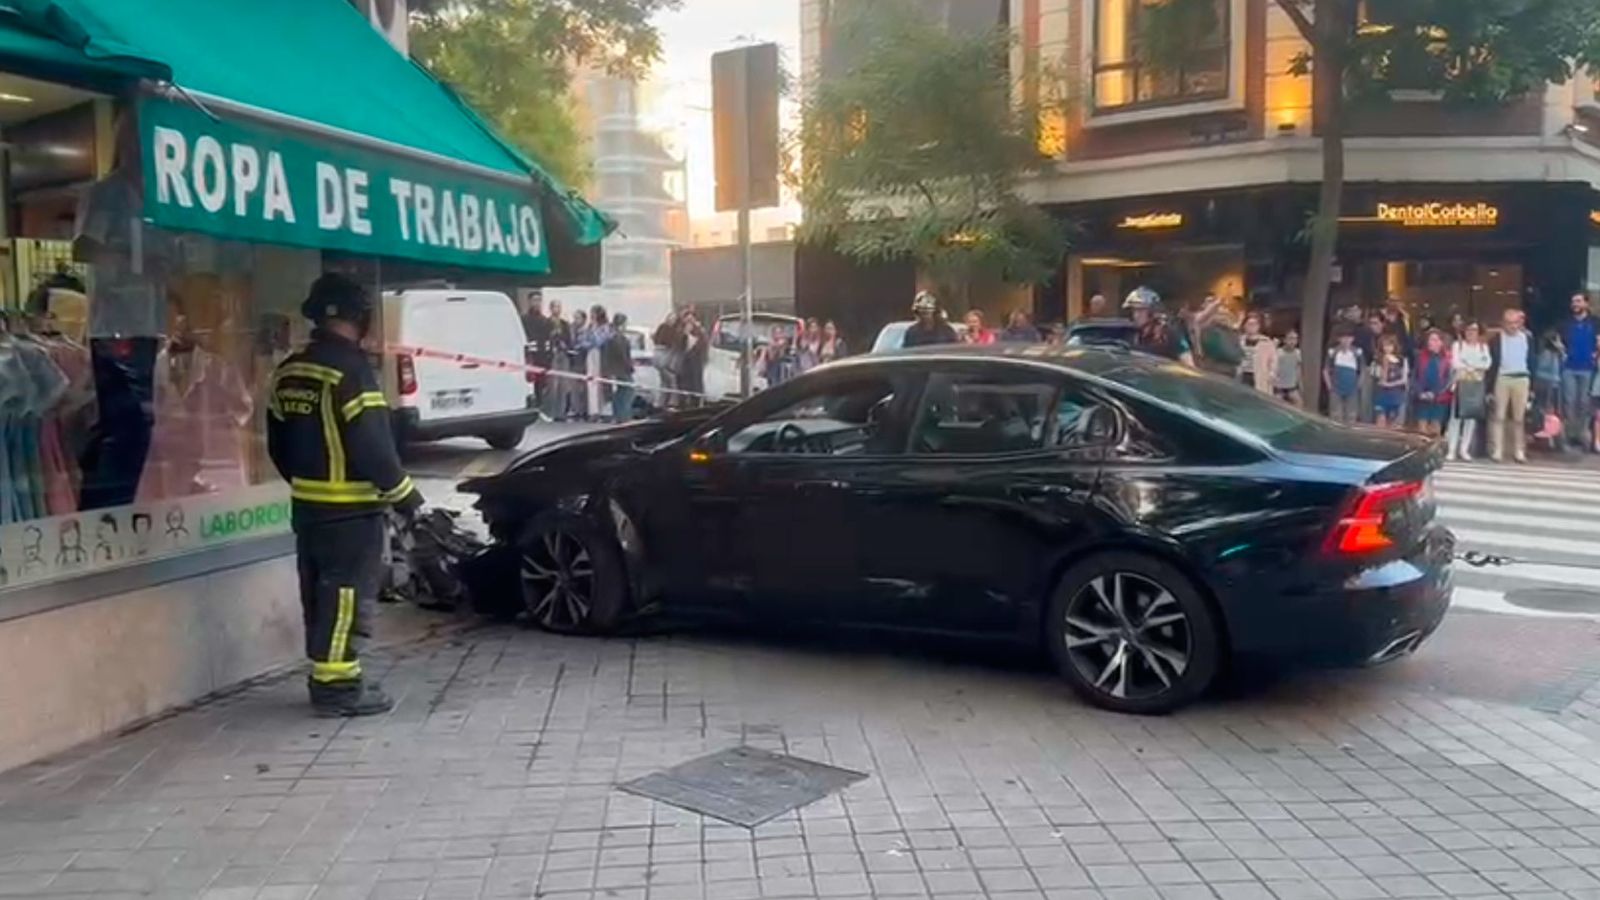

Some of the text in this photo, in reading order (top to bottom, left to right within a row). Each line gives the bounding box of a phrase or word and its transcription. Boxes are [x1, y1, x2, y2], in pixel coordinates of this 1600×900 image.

[153, 125, 541, 257] ROPA DE TRABAJO
